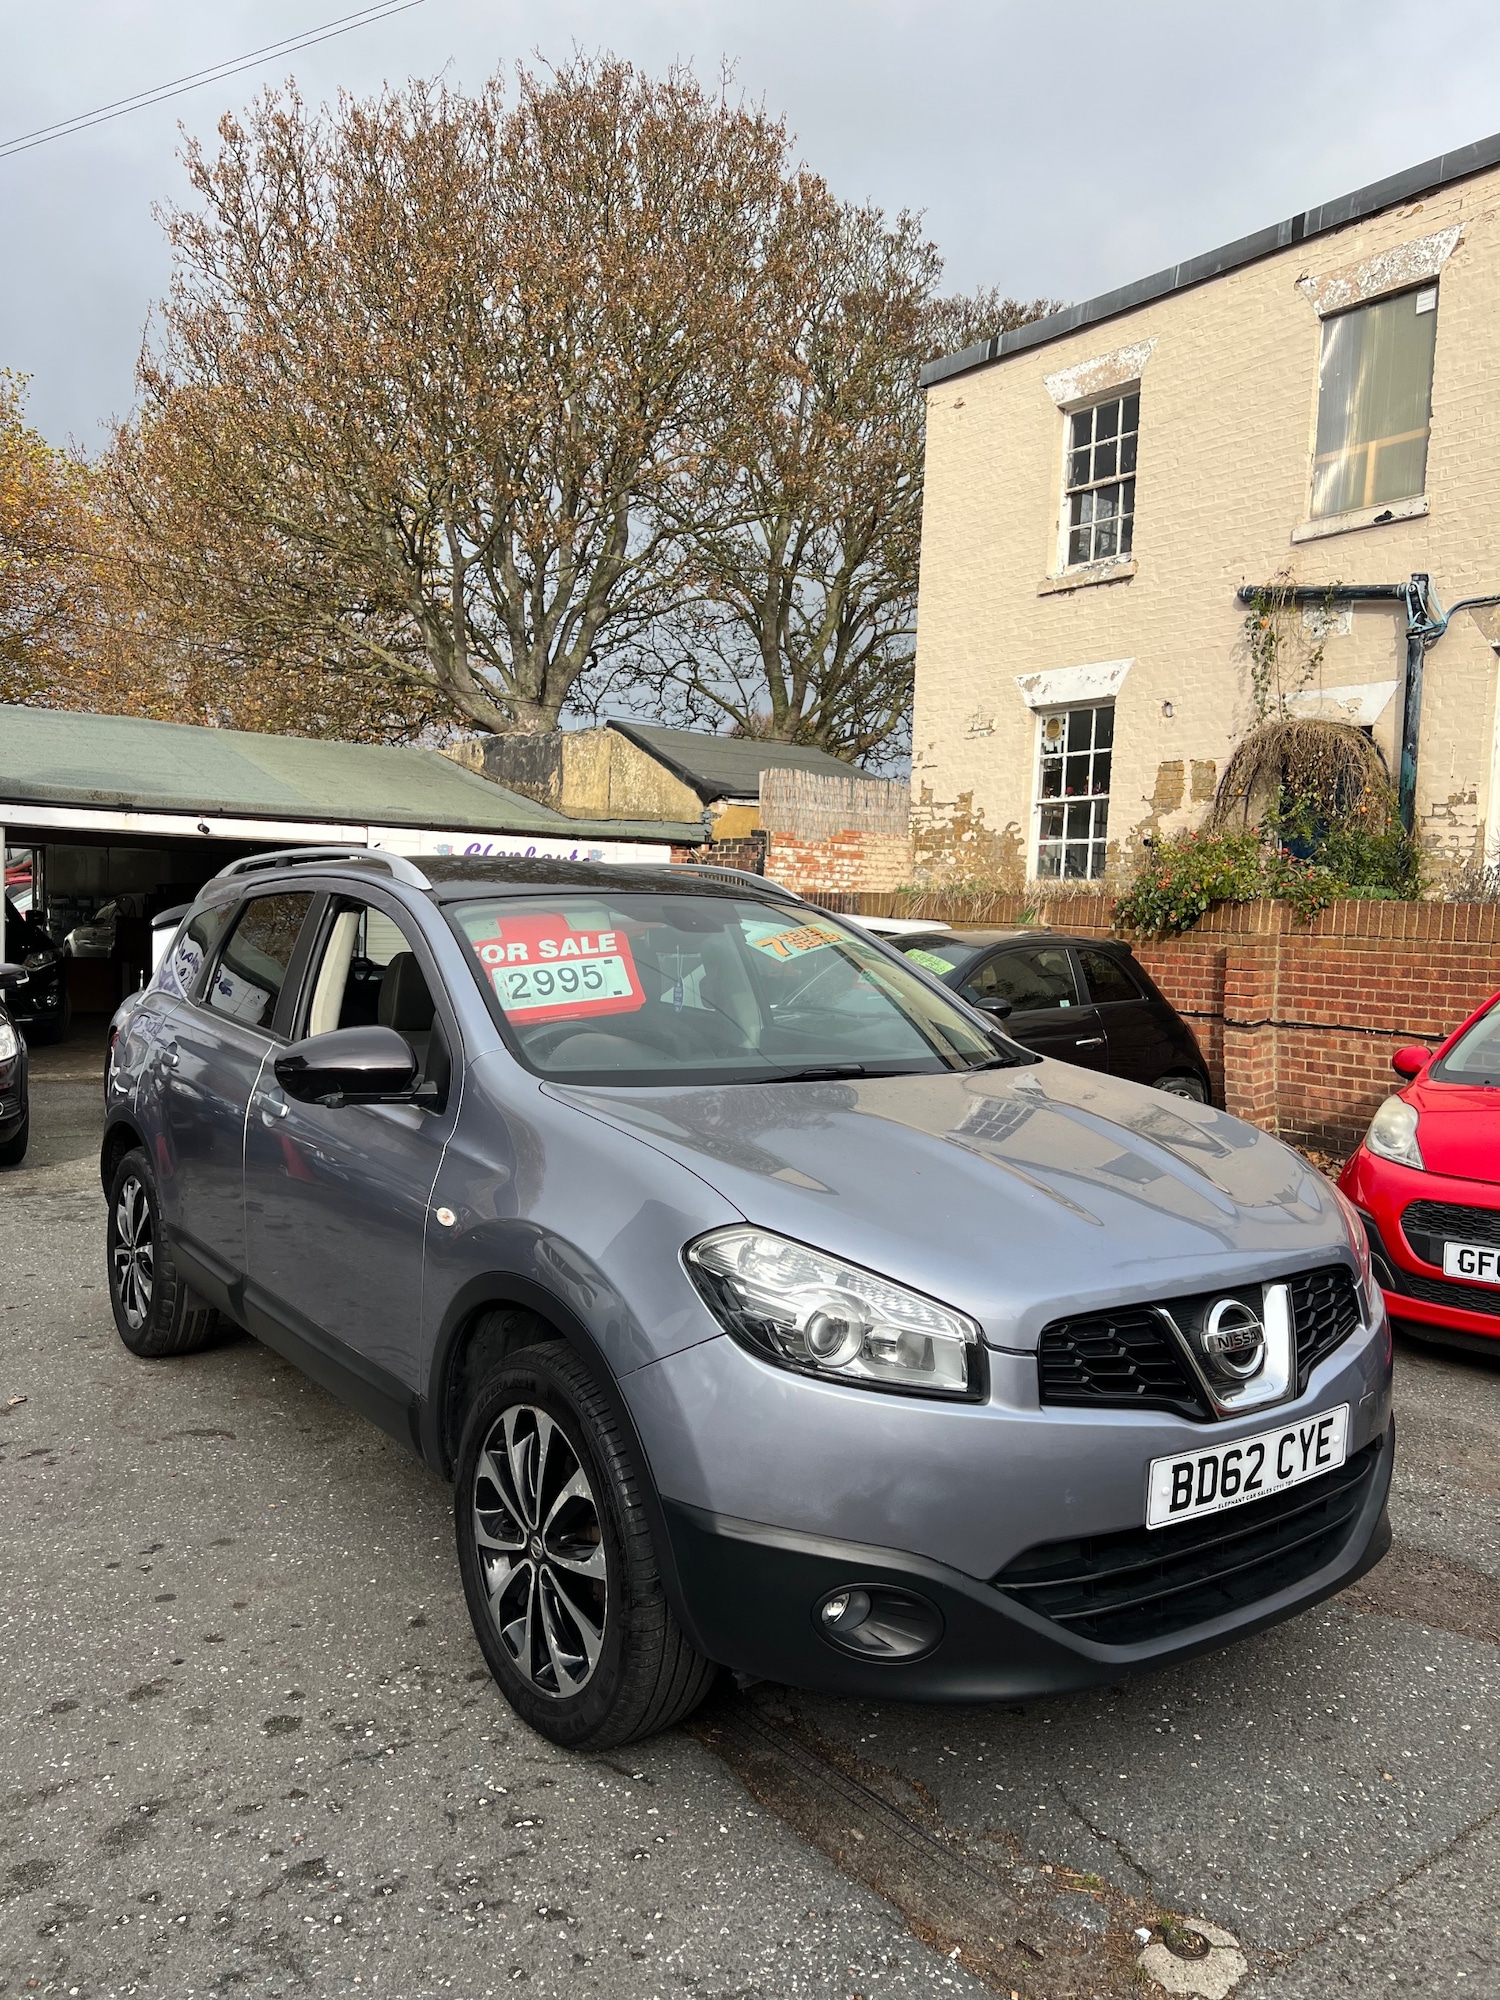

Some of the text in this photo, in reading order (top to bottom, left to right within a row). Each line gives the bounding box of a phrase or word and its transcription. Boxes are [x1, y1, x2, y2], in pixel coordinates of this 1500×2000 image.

[539, 933, 617, 959] SALE
[755, 936, 792, 957] 7
[508, 964, 603, 1000] 2995
[1457, 1249, 1500, 1278] GF
[1217, 1329, 1263, 1349] NISSAN
[1169, 1417, 1334, 1514] BD62 CYE
[1218, 1496, 1245, 1509] ELEPHANT
[1246, 1493, 1257, 1501] CAR
[1257, 1487, 1273, 1497] SALES
